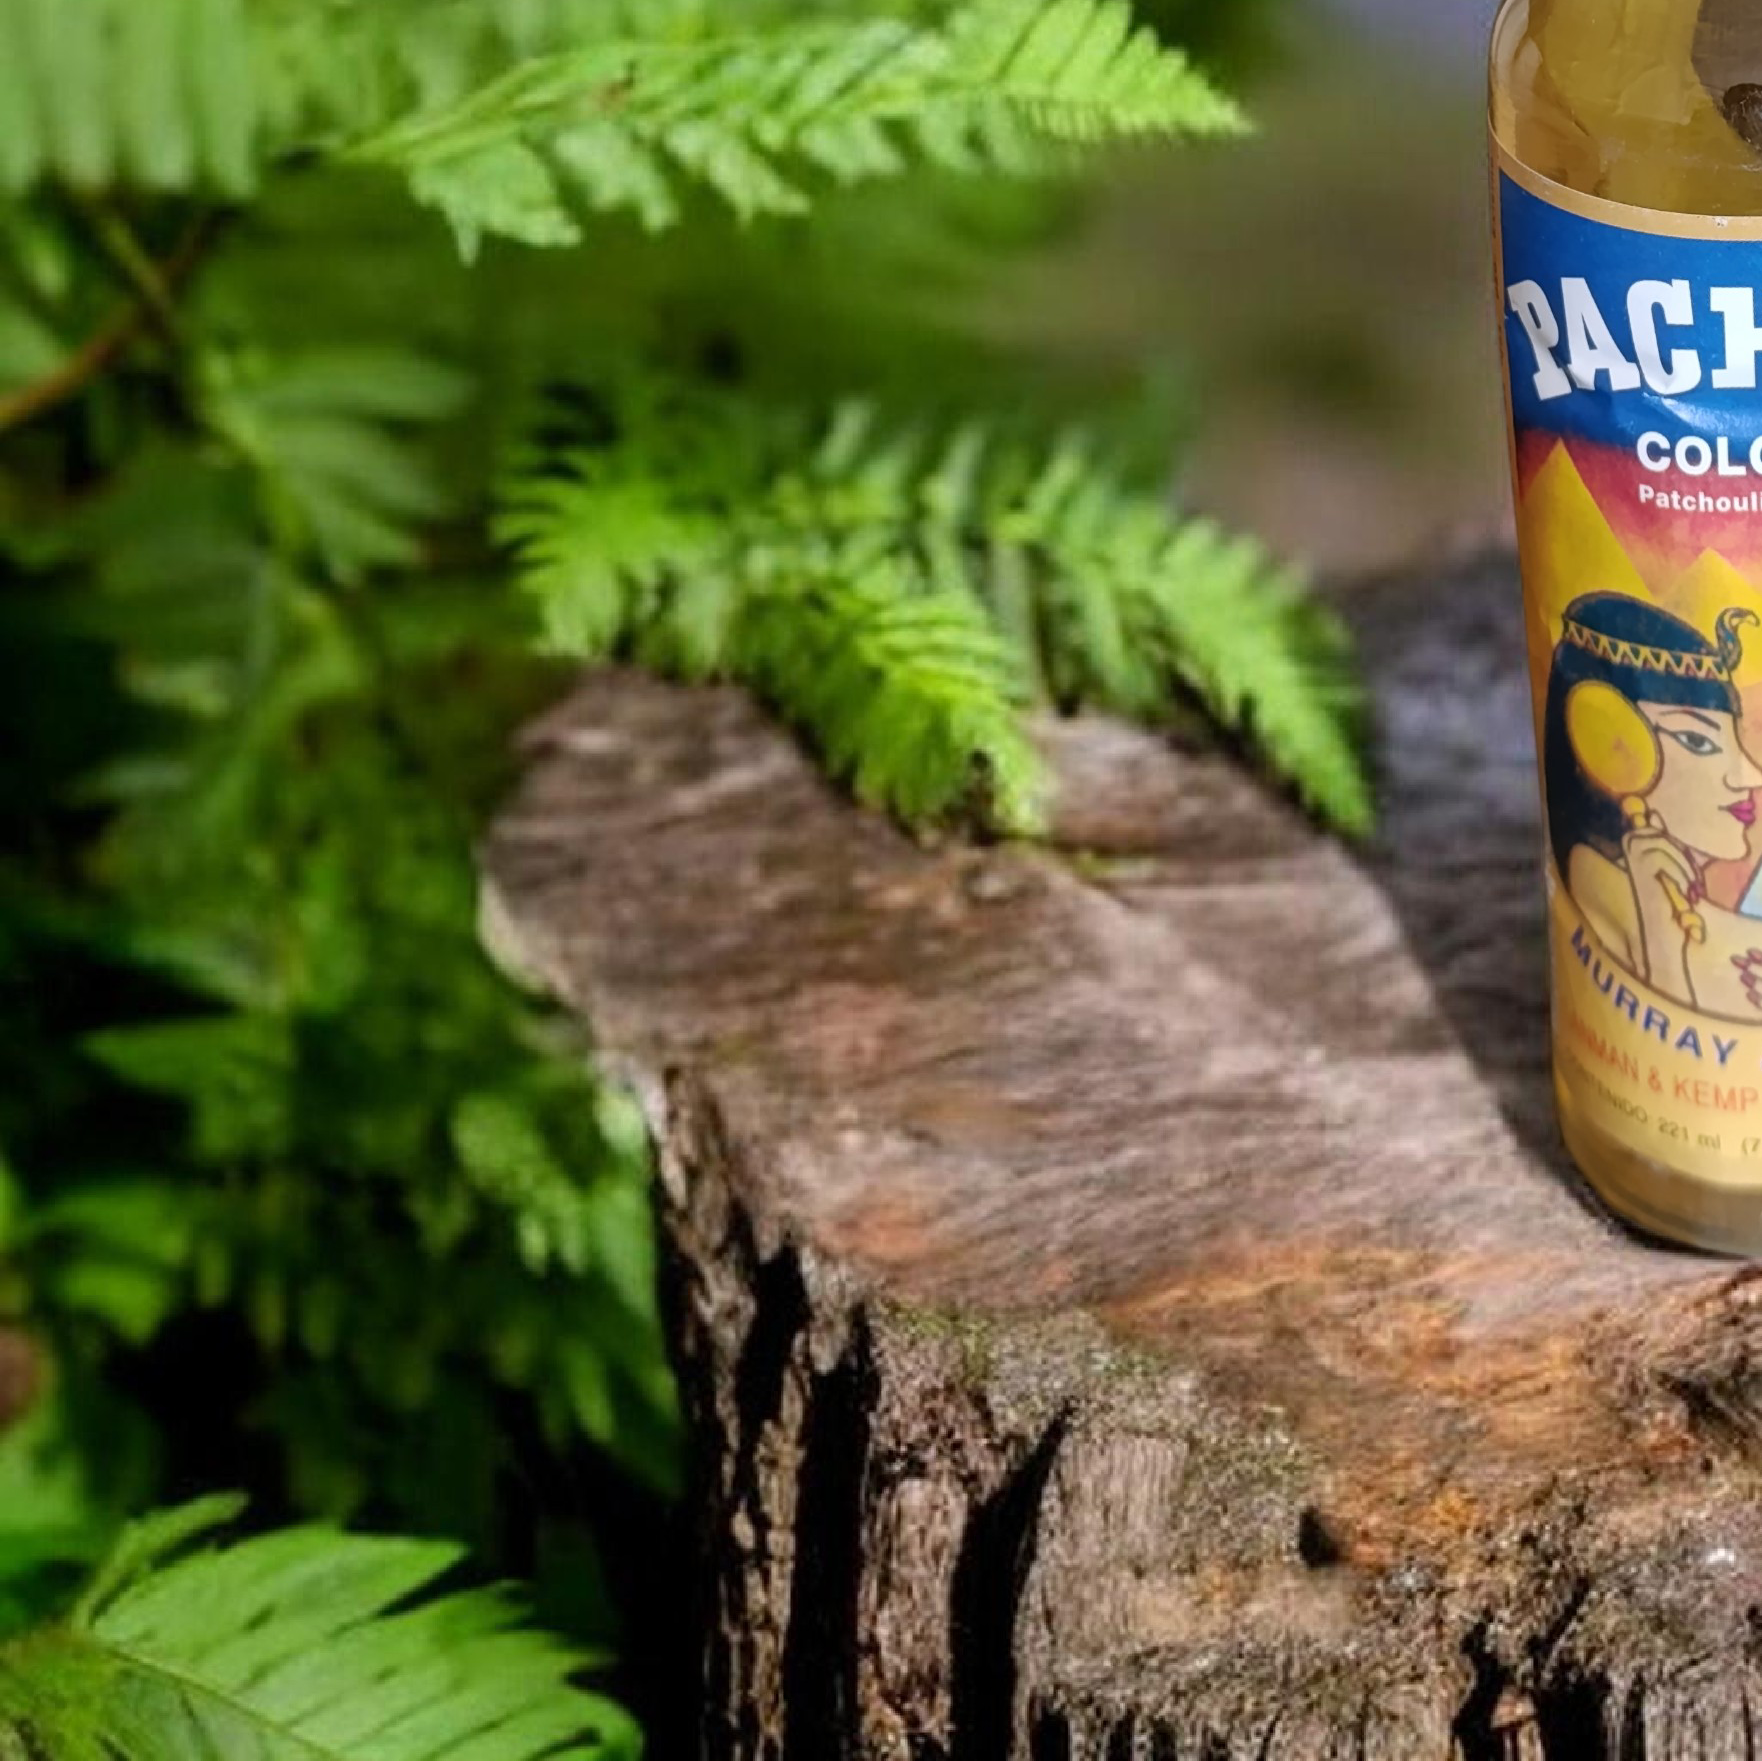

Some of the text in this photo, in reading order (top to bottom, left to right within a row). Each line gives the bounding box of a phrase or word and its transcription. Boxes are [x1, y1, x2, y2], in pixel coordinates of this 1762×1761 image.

[1570, 924, 1739, 1066] MURRAY
[1647, 1065, 1662, 1094] &
[1673, 1073, 1760, 1113] KEMP
[1657, 1116, 1689, 1142] 221
